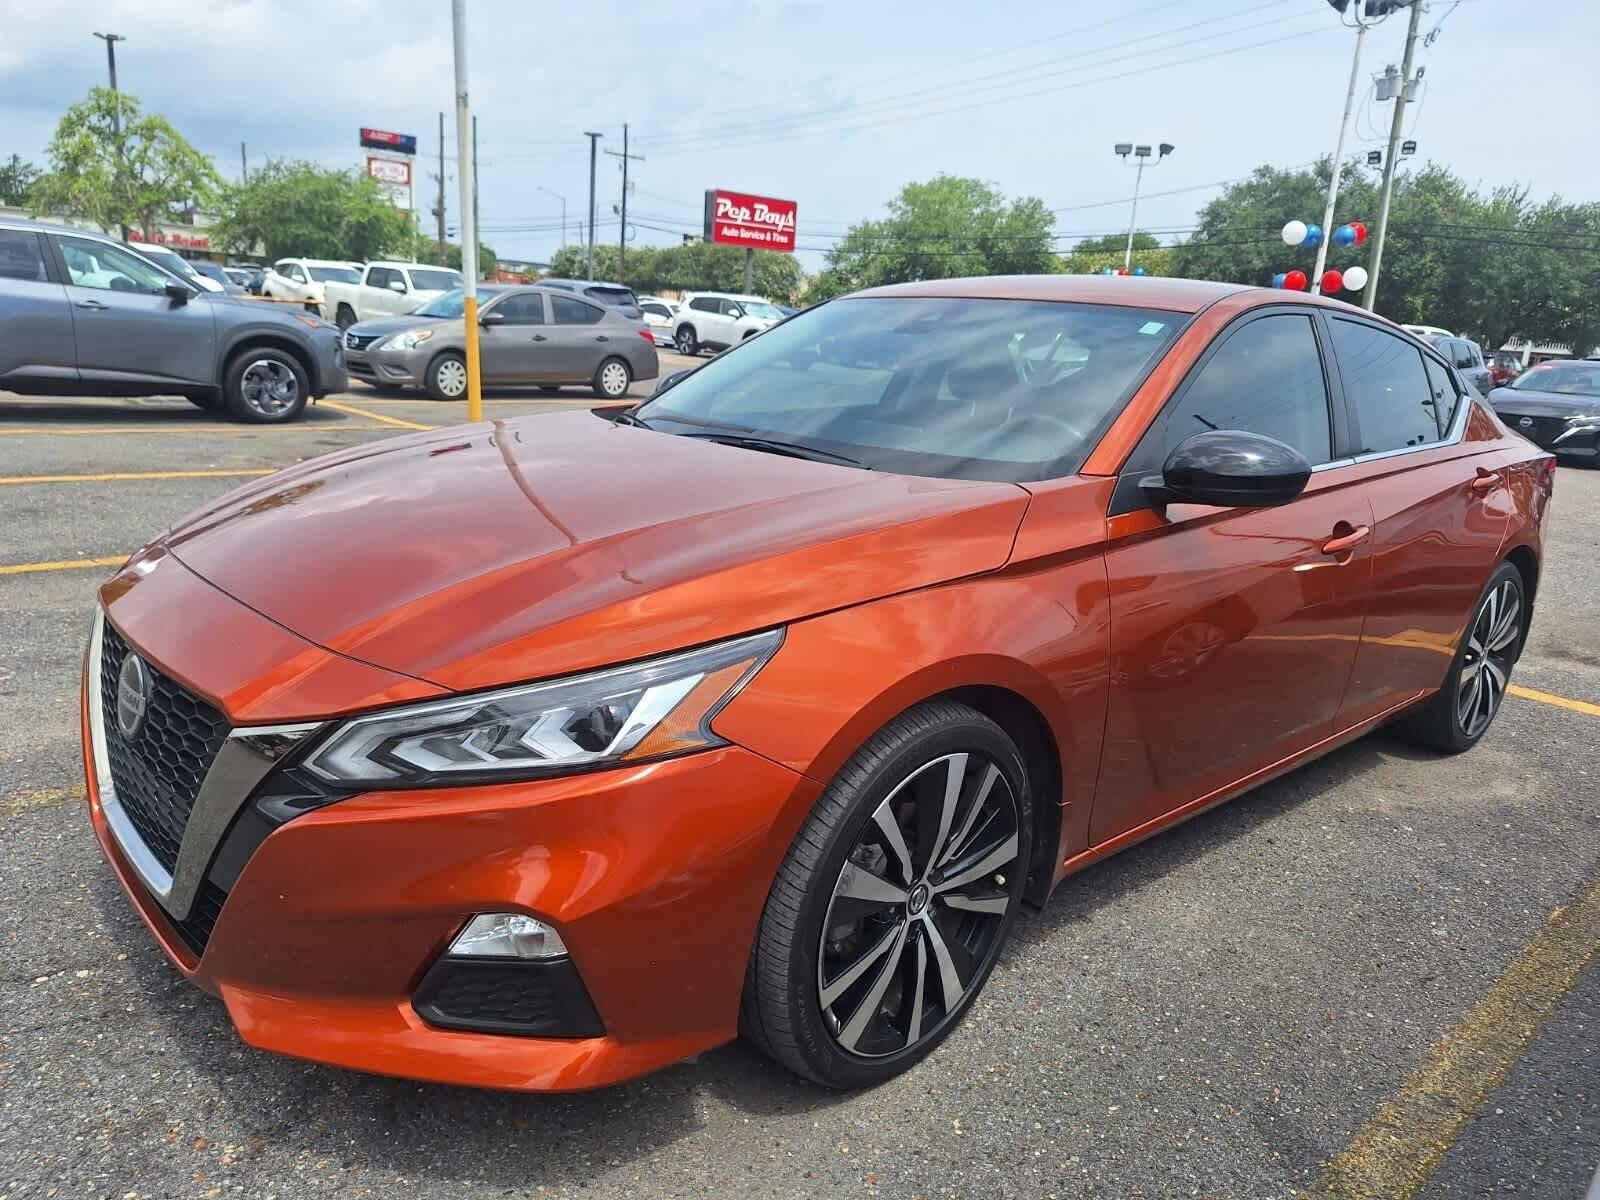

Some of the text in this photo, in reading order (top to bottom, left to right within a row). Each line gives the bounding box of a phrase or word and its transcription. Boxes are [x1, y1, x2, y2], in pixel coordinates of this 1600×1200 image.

[716, 197, 795, 232] Pep Boys
[721, 225, 739, 237] Auto
[740, 228, 765, 241] Service
[772, 231, 789, 243] Tires
